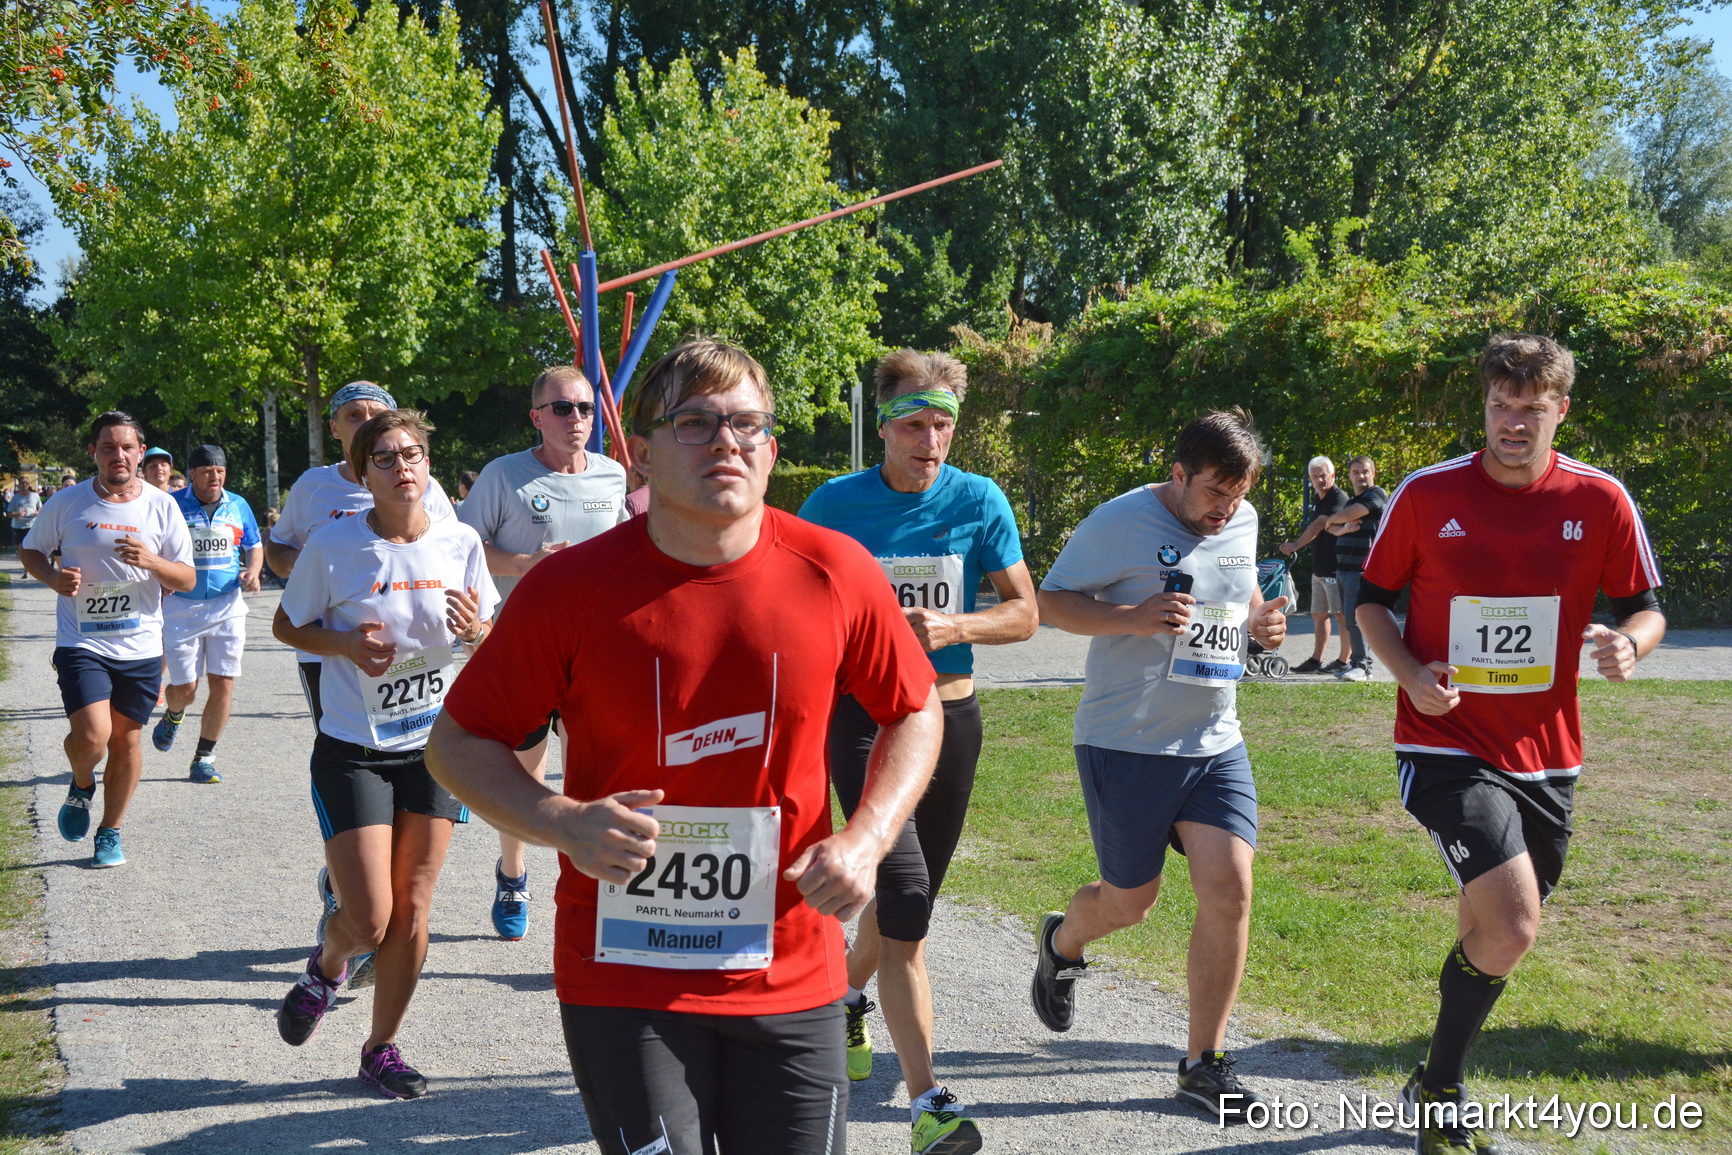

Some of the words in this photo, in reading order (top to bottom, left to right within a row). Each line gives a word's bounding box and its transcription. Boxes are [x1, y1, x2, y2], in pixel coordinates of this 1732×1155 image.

[583, 501, 613, 510] BOCK
[99, 523, 141, 534] KLEBL
[1439, 530, 1466, 538] adidas
[1562, 520, 1583, 541] 86
[194, 538, 228, 552] 3099
[1218, 556, 1251, 567] BOCK
[894, 565, 938, 576] BOCK
[392, 580, 446, 591] KLEBL
[86, 595, 131, 614] 2272
[1480, 606, 1528, 617] BOCK
[96, 622, 125, 631] Markus
[1188, 622, 1240, 652] 2490
[1476, 624, 1532, 654] 122
[386, 656, 427, 675] BOCK
[1471, 656, 1494, 664] PARTL
[1495, 657, 1527, 665] Neumarkt
[1195, 664, 1229, 677] Markus
[1487, 671, 1519, 683] Timo
[377, 668, 444, 710] 2275
[389, 707, 410, 718] PARTL
[410, 700, 436, 712] Neumarkt
[401, 713, 437, 732] Nadine
[692, 726, 737, 753] DEHN
[658, 820, 730, 839] BOCK
[1449, 840, 1470, 863] 86
[625, 852, 750, 901] 2430
[609, 884, 615, 893] B
[636, 905, 672, 917] PARTL
[674, 908, 724, 918] Neumarkt
[647, 927, 723, 949] Manuel
